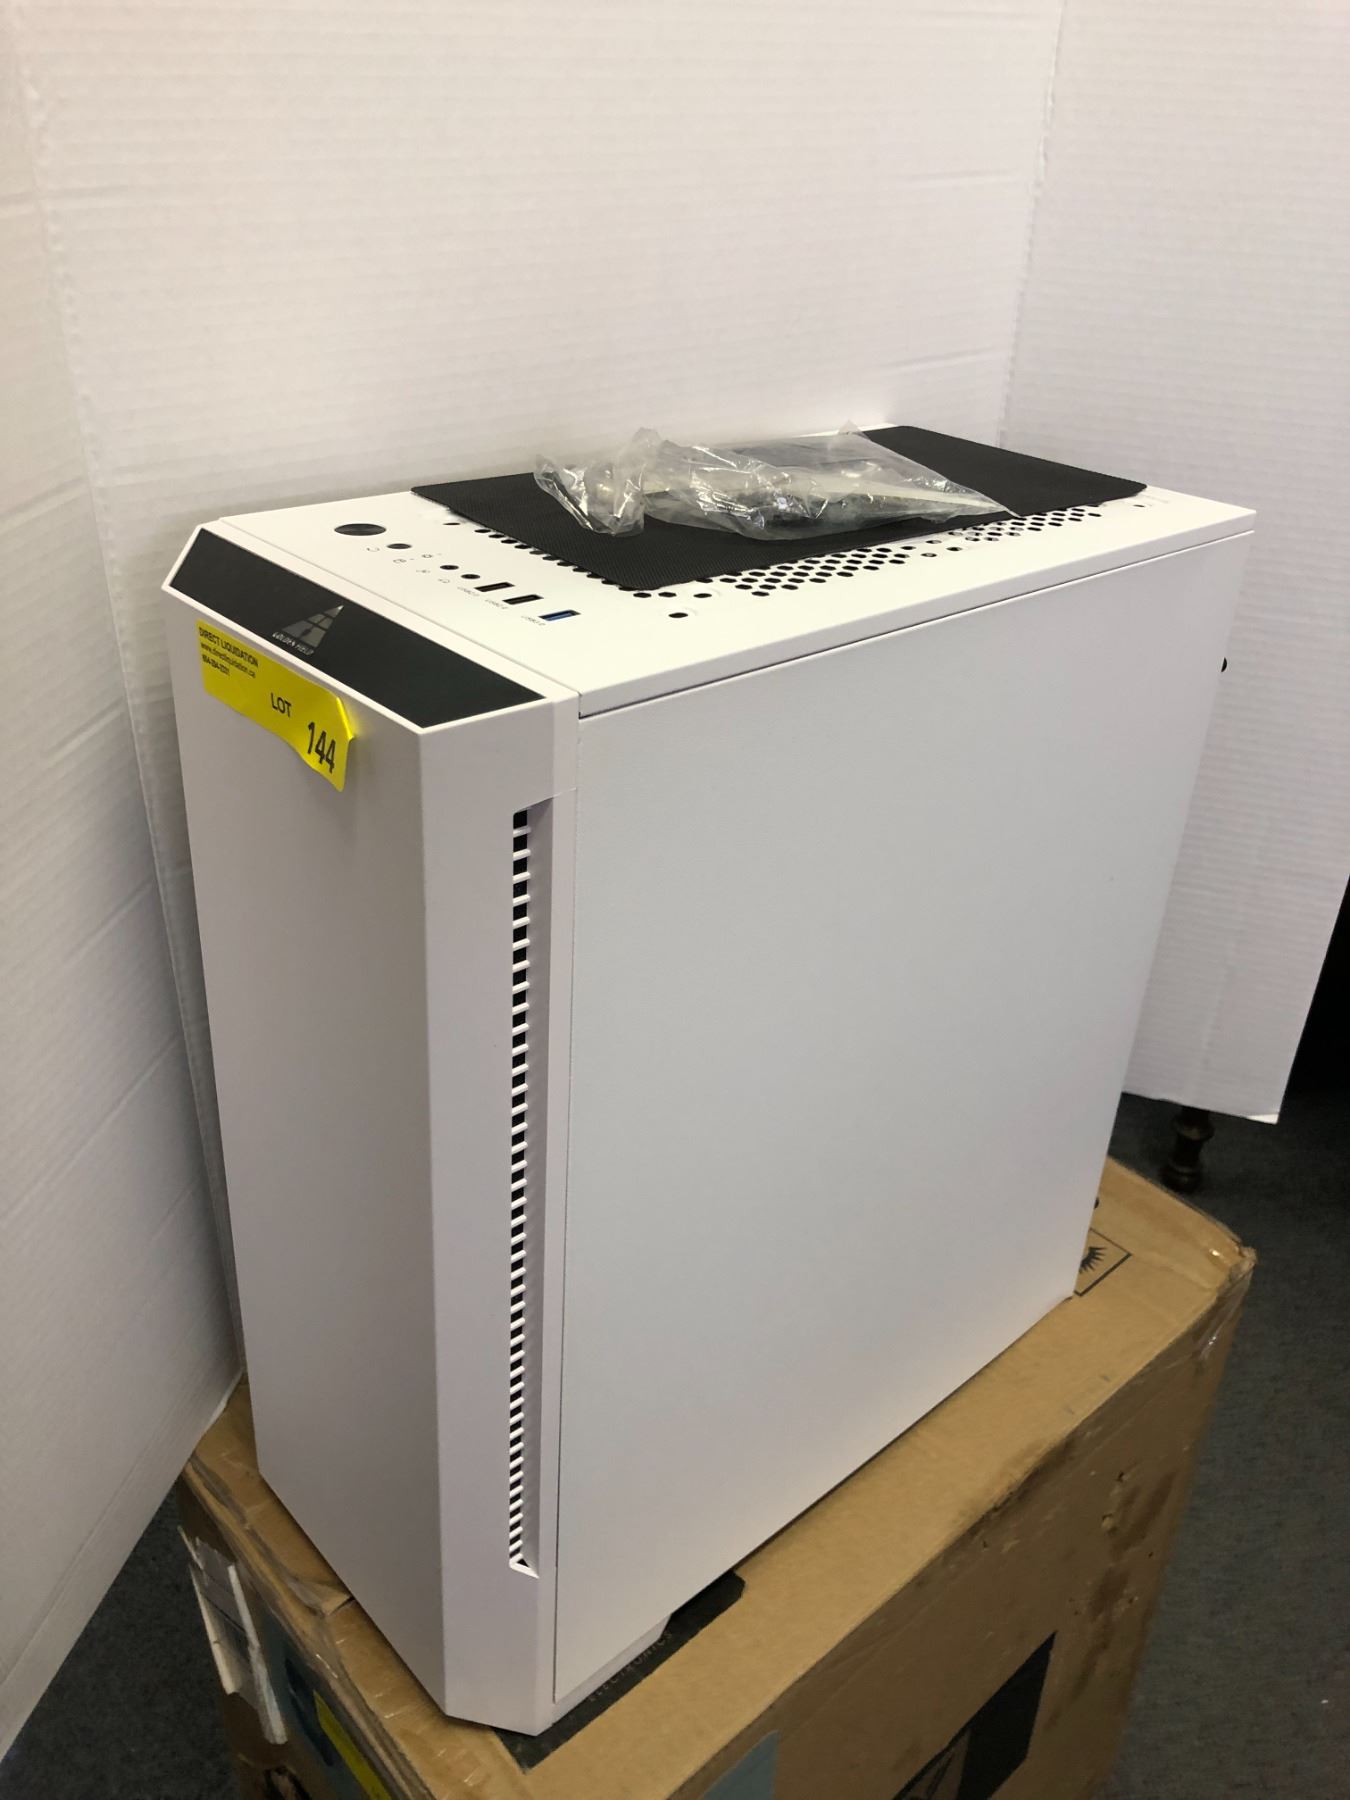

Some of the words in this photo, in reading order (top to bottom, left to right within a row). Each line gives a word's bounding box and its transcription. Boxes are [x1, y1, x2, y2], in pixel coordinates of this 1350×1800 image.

[198, 626, 220, 646] DIRECT
[220, 639, 259, 668] LIQUIDATION
[270, 692, 292, 717] LOT
[307, 722, 336, 774] 144
